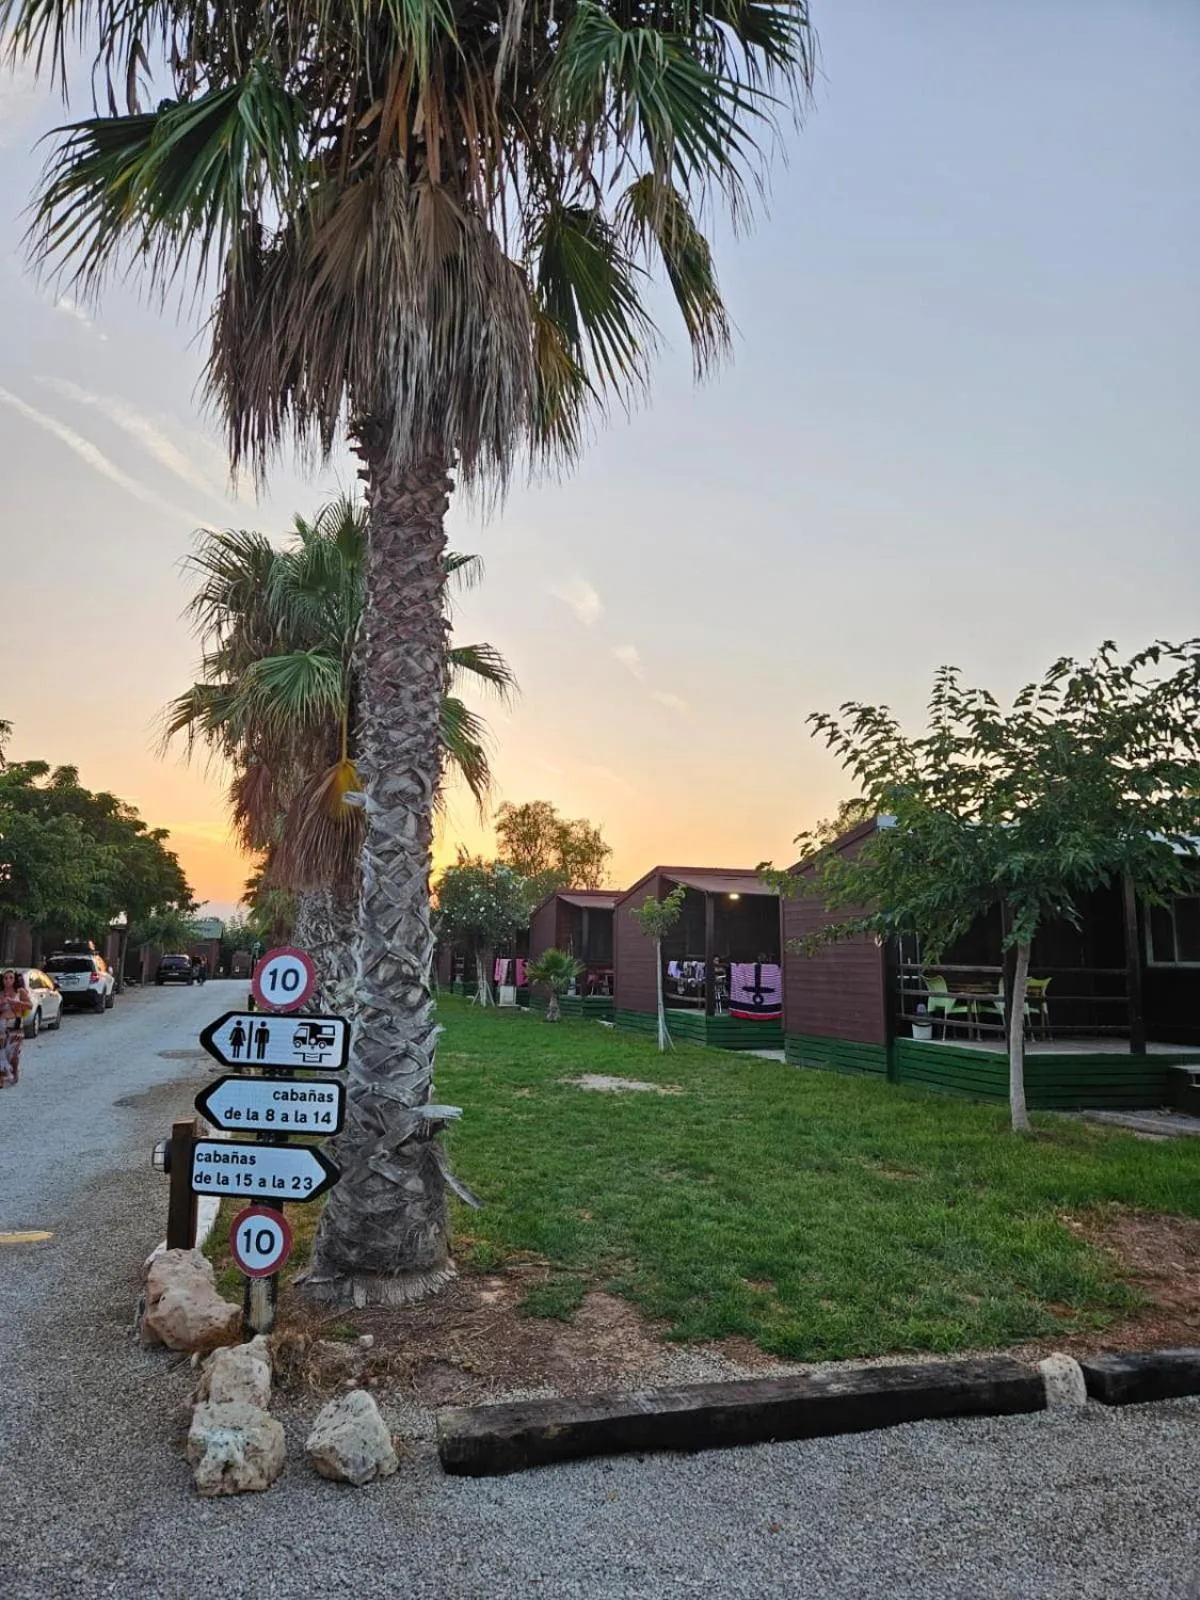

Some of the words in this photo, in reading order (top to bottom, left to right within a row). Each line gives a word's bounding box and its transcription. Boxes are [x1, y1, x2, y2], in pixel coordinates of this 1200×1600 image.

[268, 968, 300, 991] 10
[273, 1088, 334, 1103] cabañas
[224, 1107, 241, 1120] de
[246, 1107, 259, 1121] la
[265, 1109, 275, 1122] 8
[281, 1113, 289, 1123] a
[294, 1111, 307, 1124] la
[314, 1111, 332, 1124] 14
[196, 1150, 256, 1165] cabañas
[194, 1172, 212, 1184] de
[216, 1172, 229, 1185] la
[235, 1173, 252, 1187] 15
[258, 1177, 266, 1188] a
[272, 1175, 285, 1188] la
[291, 1177, 312, 1190] 23
[243, 1229, 275, 1255] 10
